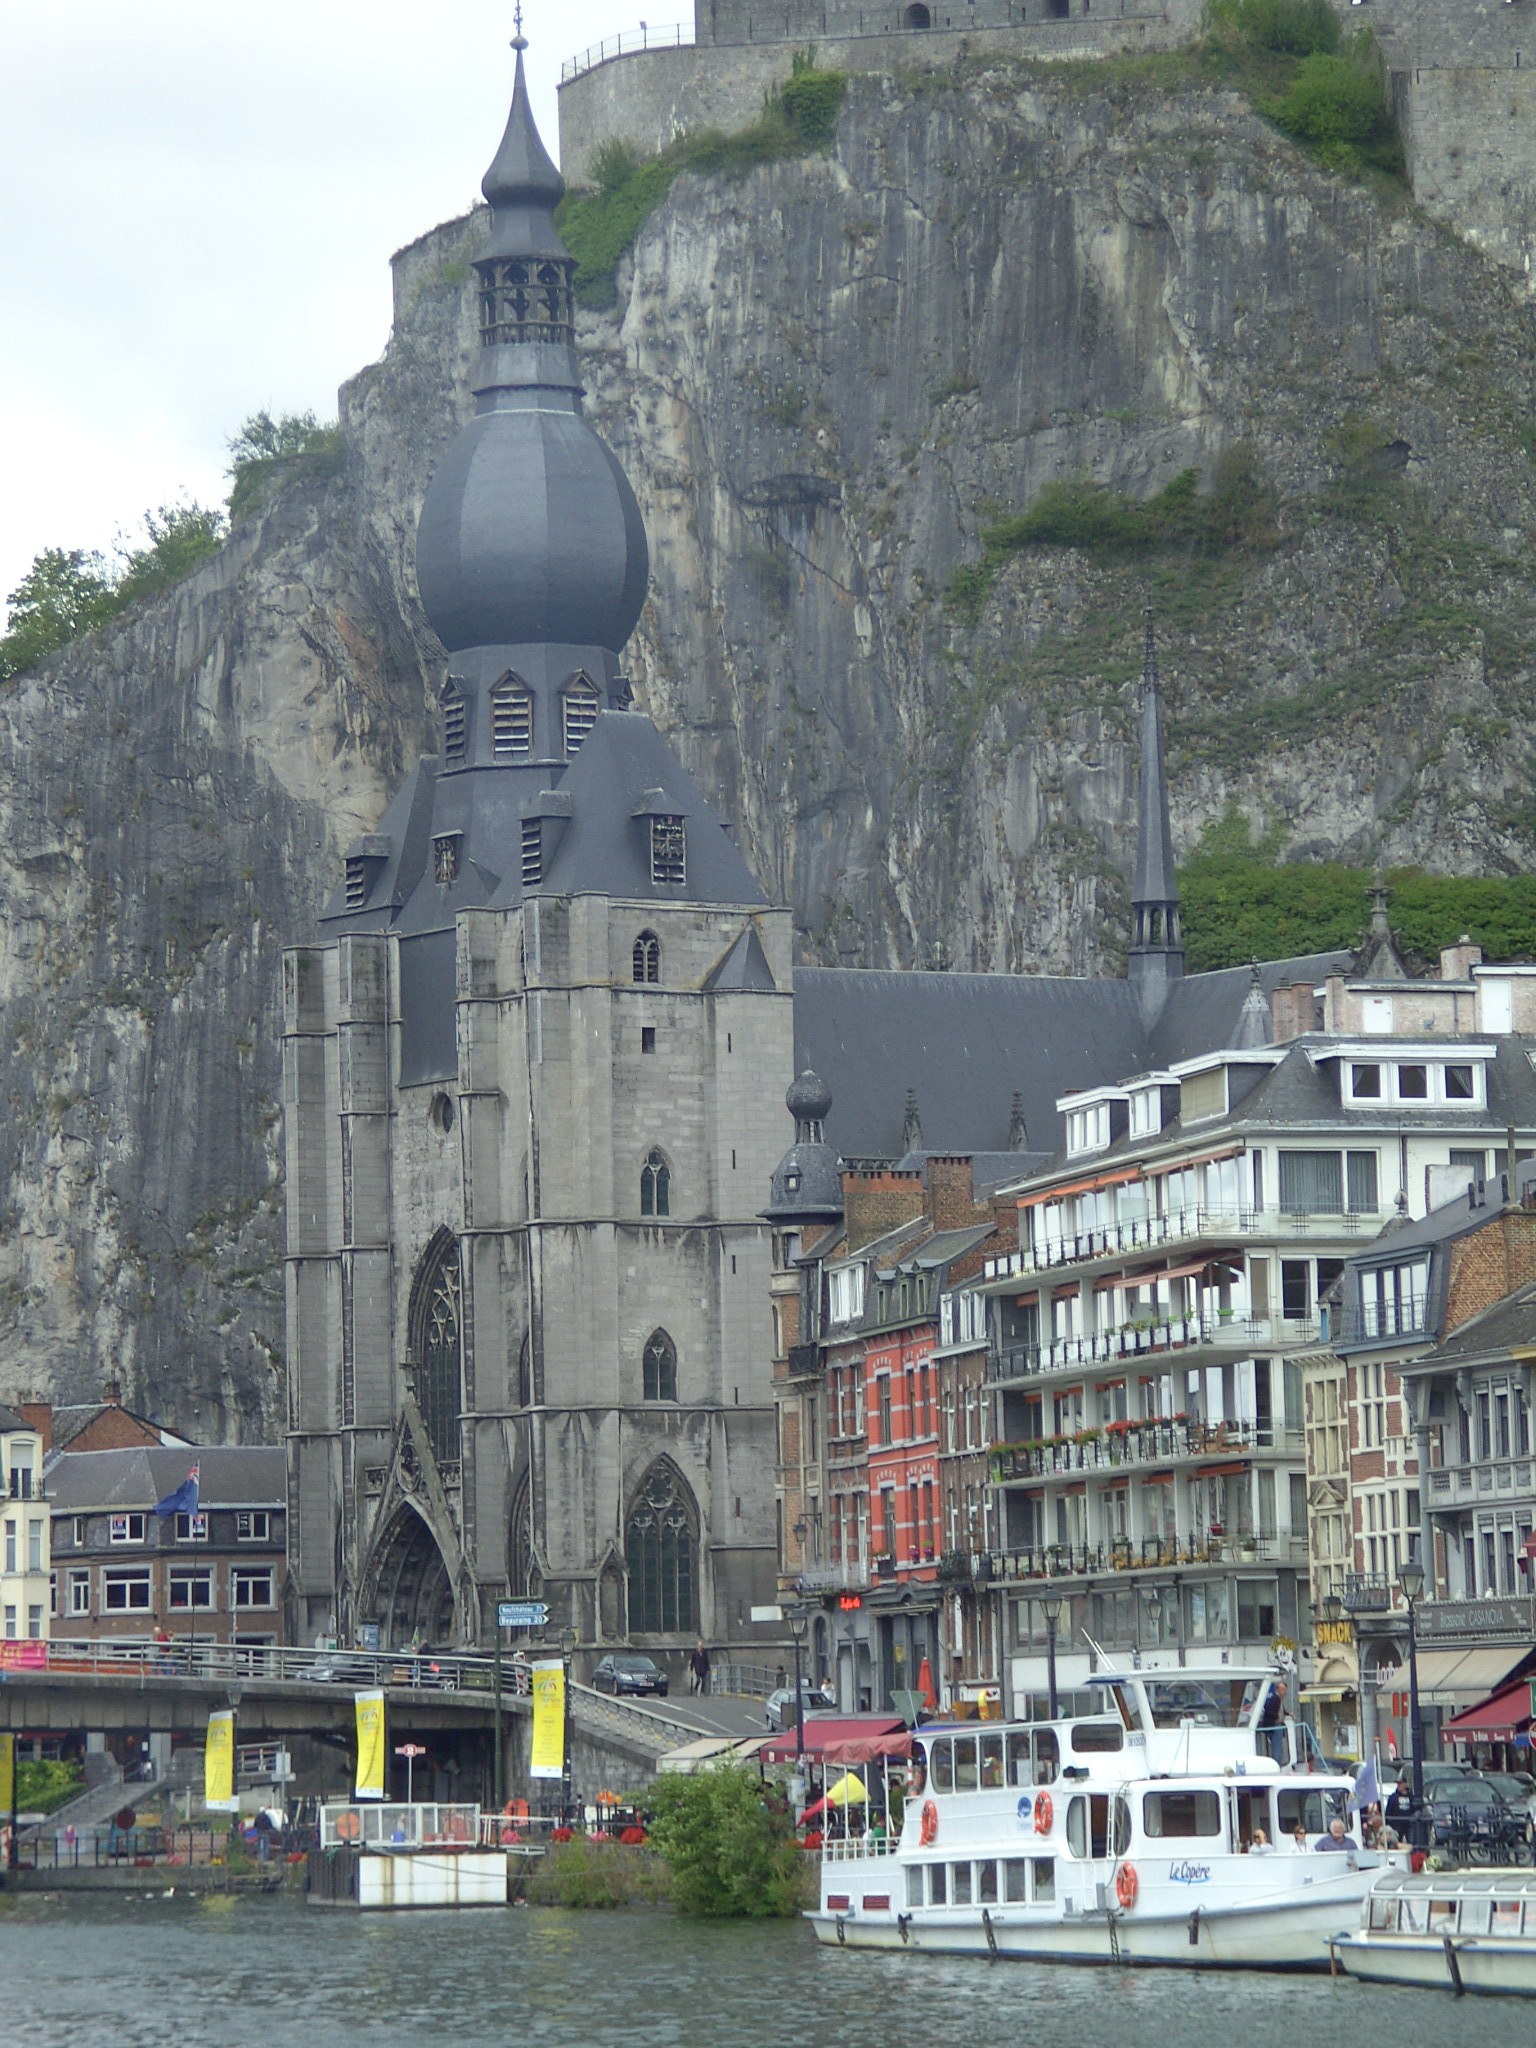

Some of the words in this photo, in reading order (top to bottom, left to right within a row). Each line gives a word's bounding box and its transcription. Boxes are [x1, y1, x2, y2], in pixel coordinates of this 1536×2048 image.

[502, 1615, 531, 1625] Beauraing
[534, 1615, 543, 1623] 20
[1468, 1608, 1505, 1626] CASANOVA
[1317, 1621, 1352, 1643] SNACK
[1169, 1861, 1180, 1880] Le
[1180, 1860, 1211, 1885] Copère
